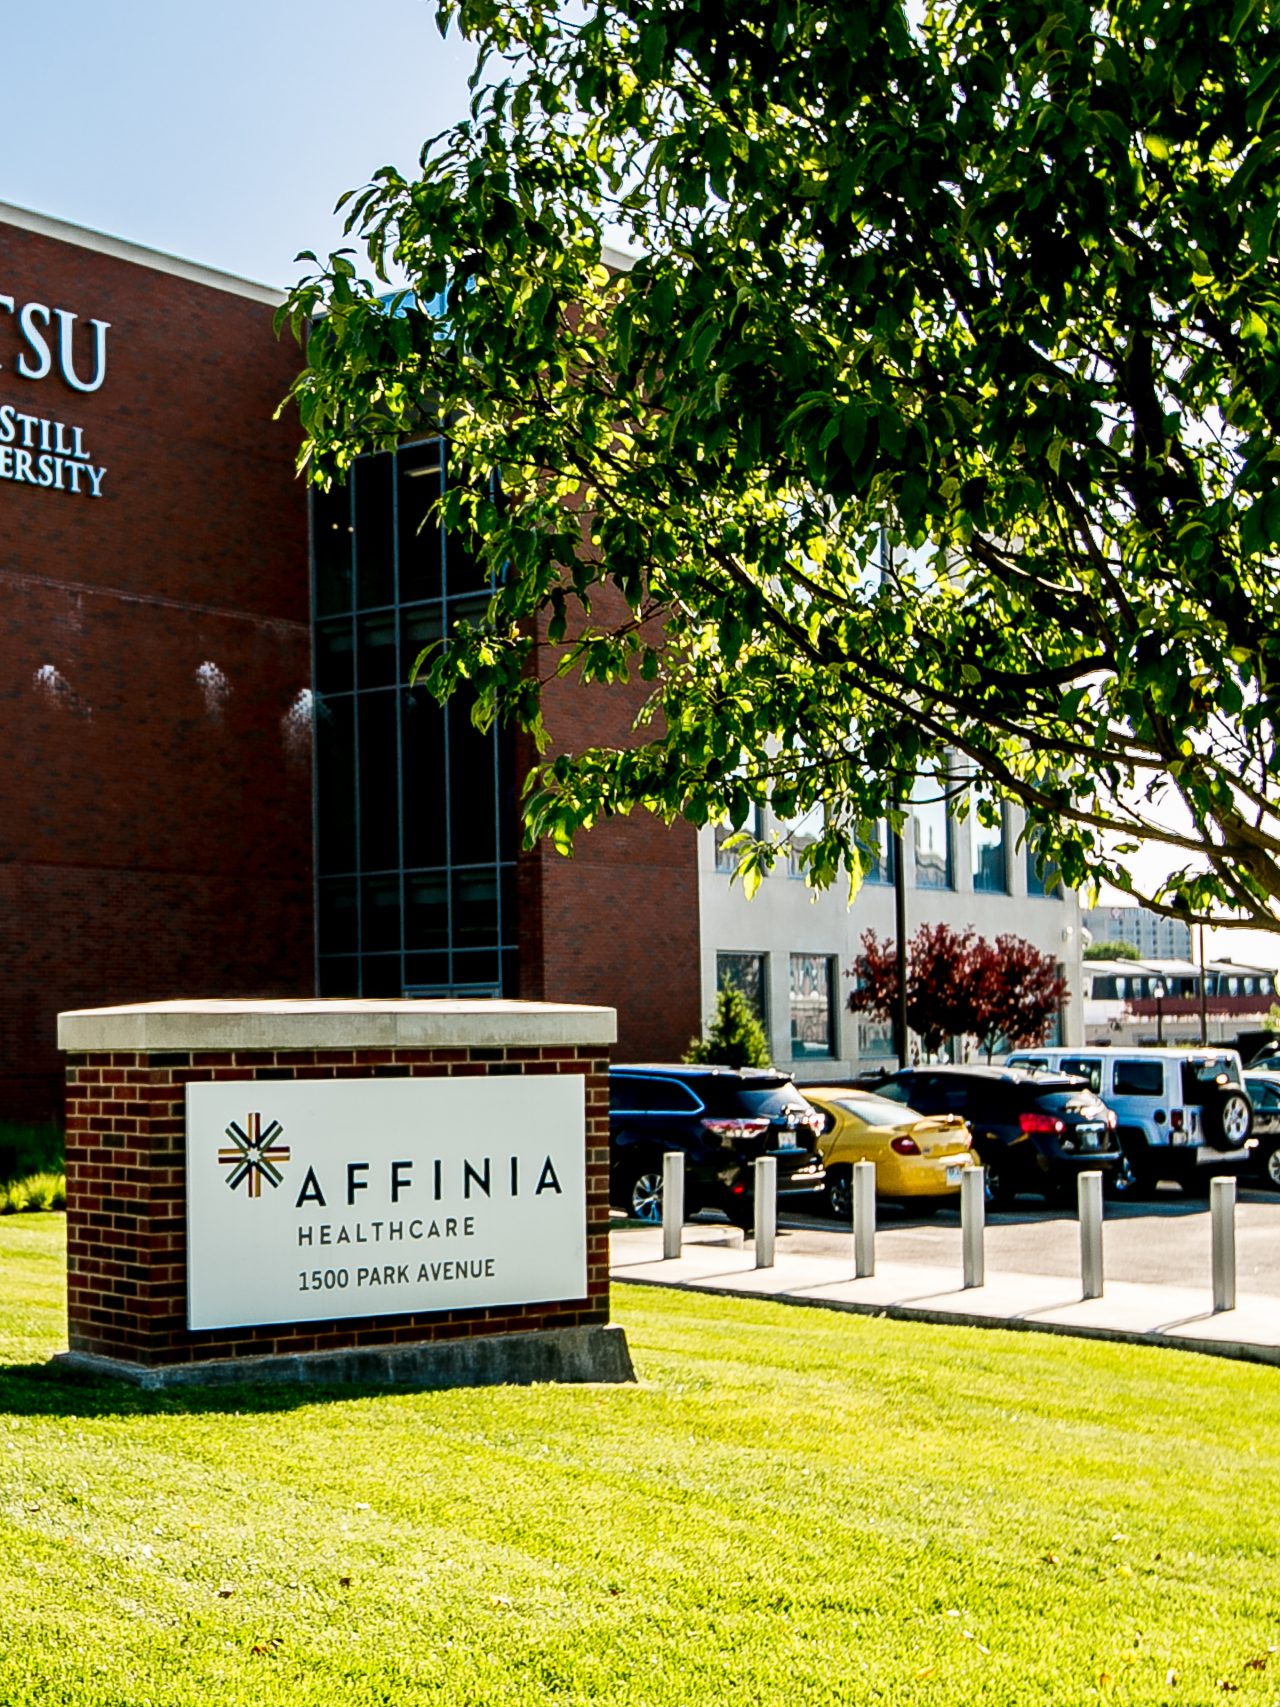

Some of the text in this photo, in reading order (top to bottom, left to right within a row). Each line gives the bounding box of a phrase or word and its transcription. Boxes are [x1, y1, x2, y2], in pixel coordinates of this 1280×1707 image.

[295, 1155, 563, 1208] AFFINIA
[298, 1216, 476, 1247] HEALTHCARE
[298, 1258, 496, 1291] 1500 PARK AVENUE
